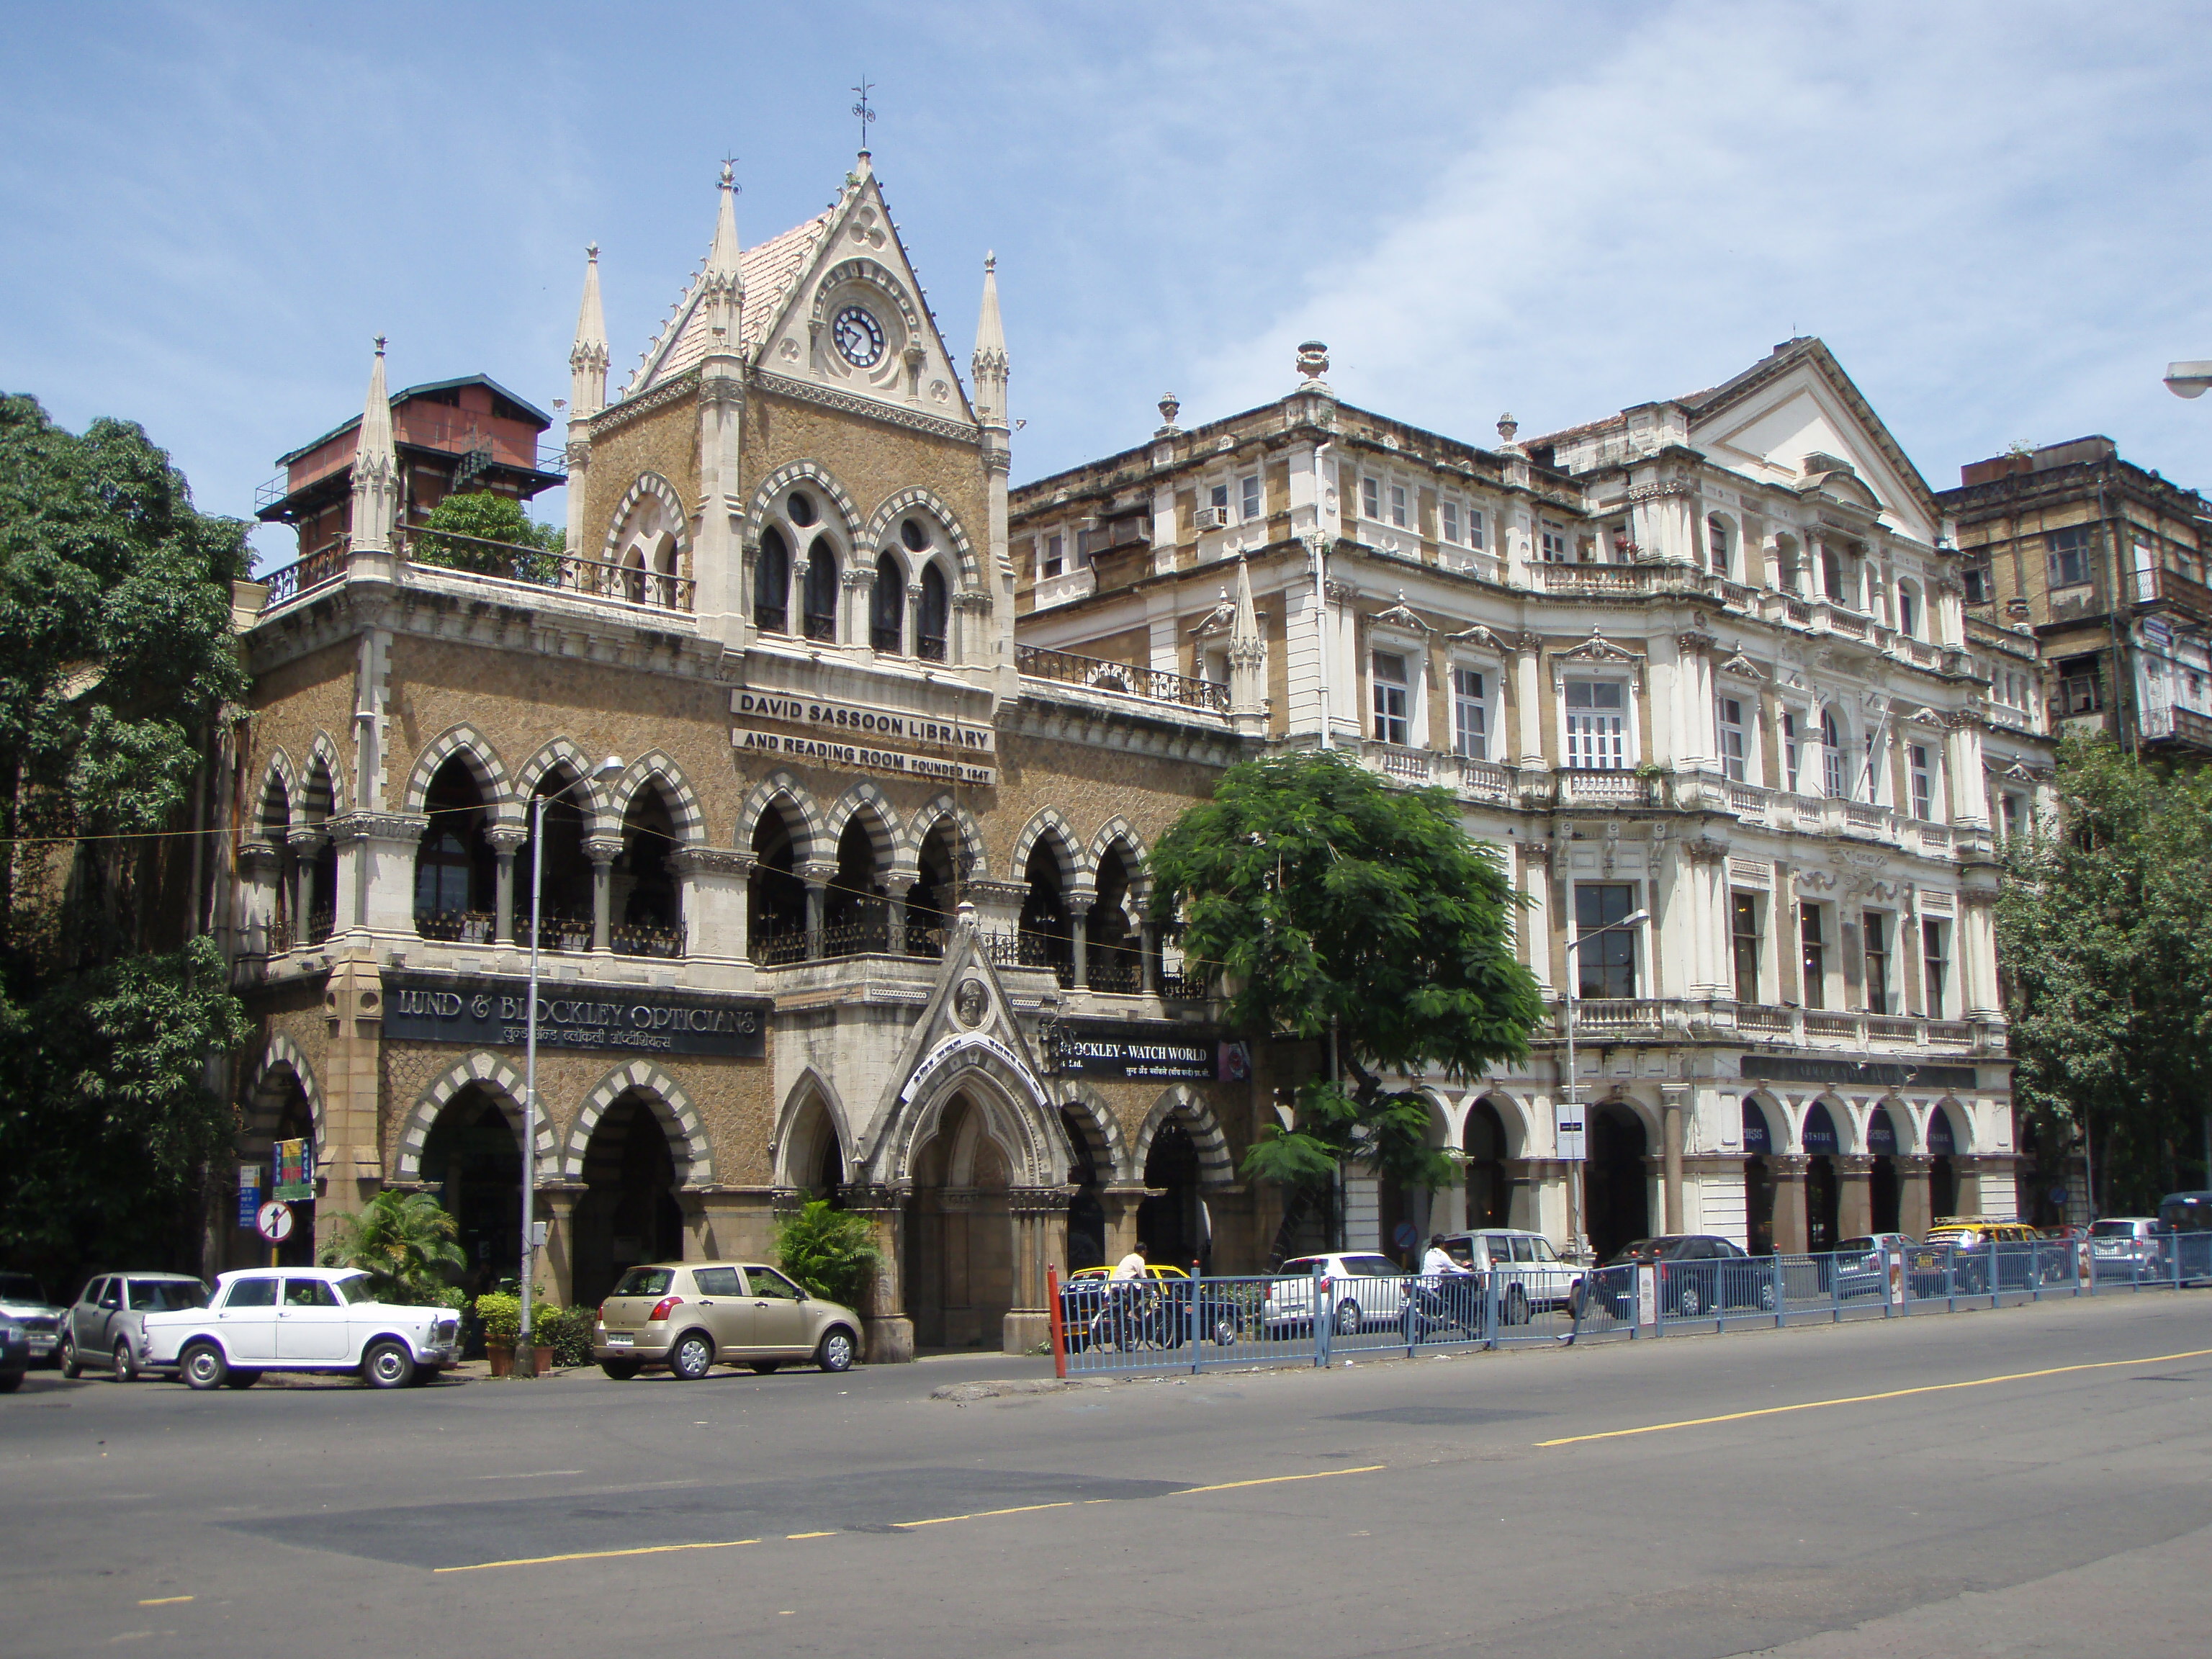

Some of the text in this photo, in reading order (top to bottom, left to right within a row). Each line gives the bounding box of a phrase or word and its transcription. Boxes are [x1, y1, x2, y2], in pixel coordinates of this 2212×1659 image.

[741, 695, 988, 750] DAVID SASSOON LIBRARY
[744, 732, 989, 781] AND READING ROOM FOUNDED 1847
[398, 990, 756, 1034] LUND & BLOCKLEY OPTICIANS
[1069, 1058, 1084, 1068] Ltd.
[1128, 1045, 1166, 1060] WATCH
[1169, 1047, 1207, 1061] WORLD
